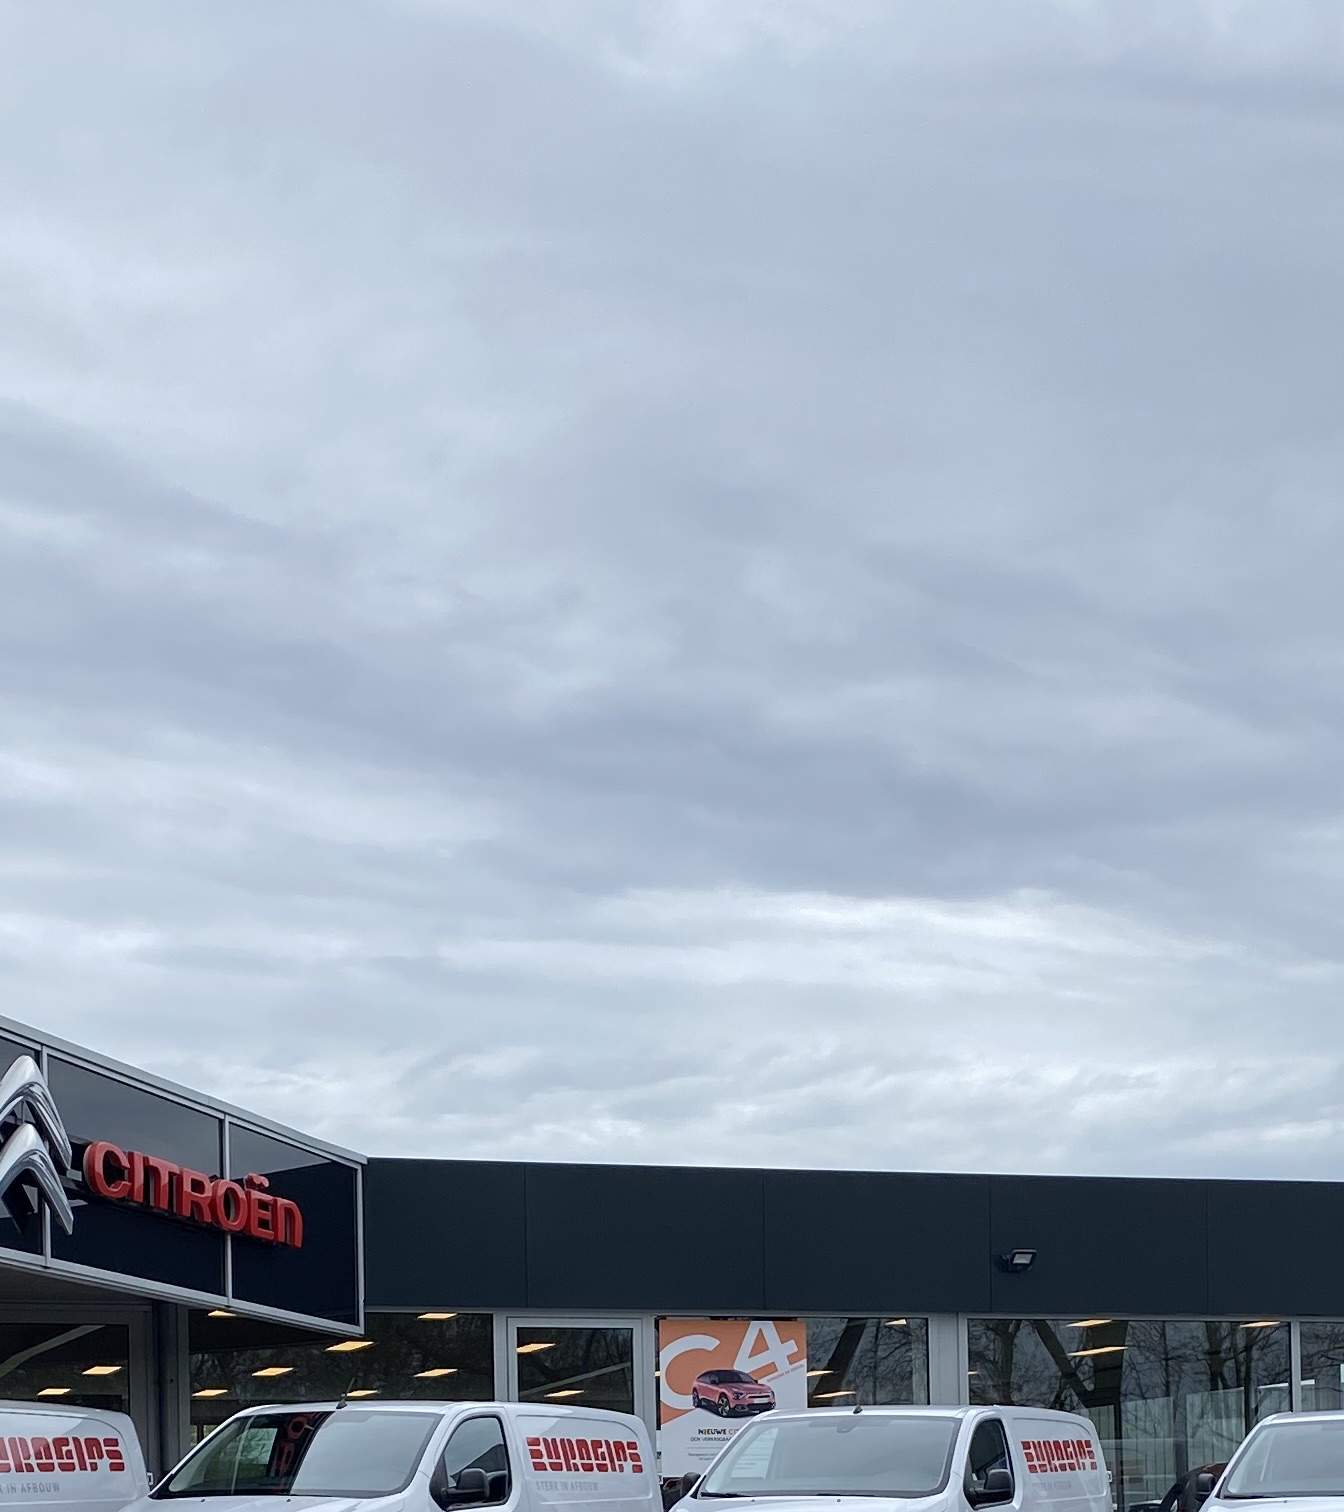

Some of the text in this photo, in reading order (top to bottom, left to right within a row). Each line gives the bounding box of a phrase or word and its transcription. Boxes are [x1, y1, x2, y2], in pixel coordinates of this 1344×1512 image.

[660, 1320, 799, 1410] C4
[526, 1436, 644, 1474] EUROGIPS
[1020, 1439, 1098, 1474] EUROGIPS
[7, 1484, 17, 1494] IN
[20, 1482, 60, 1494] AFBOUW
